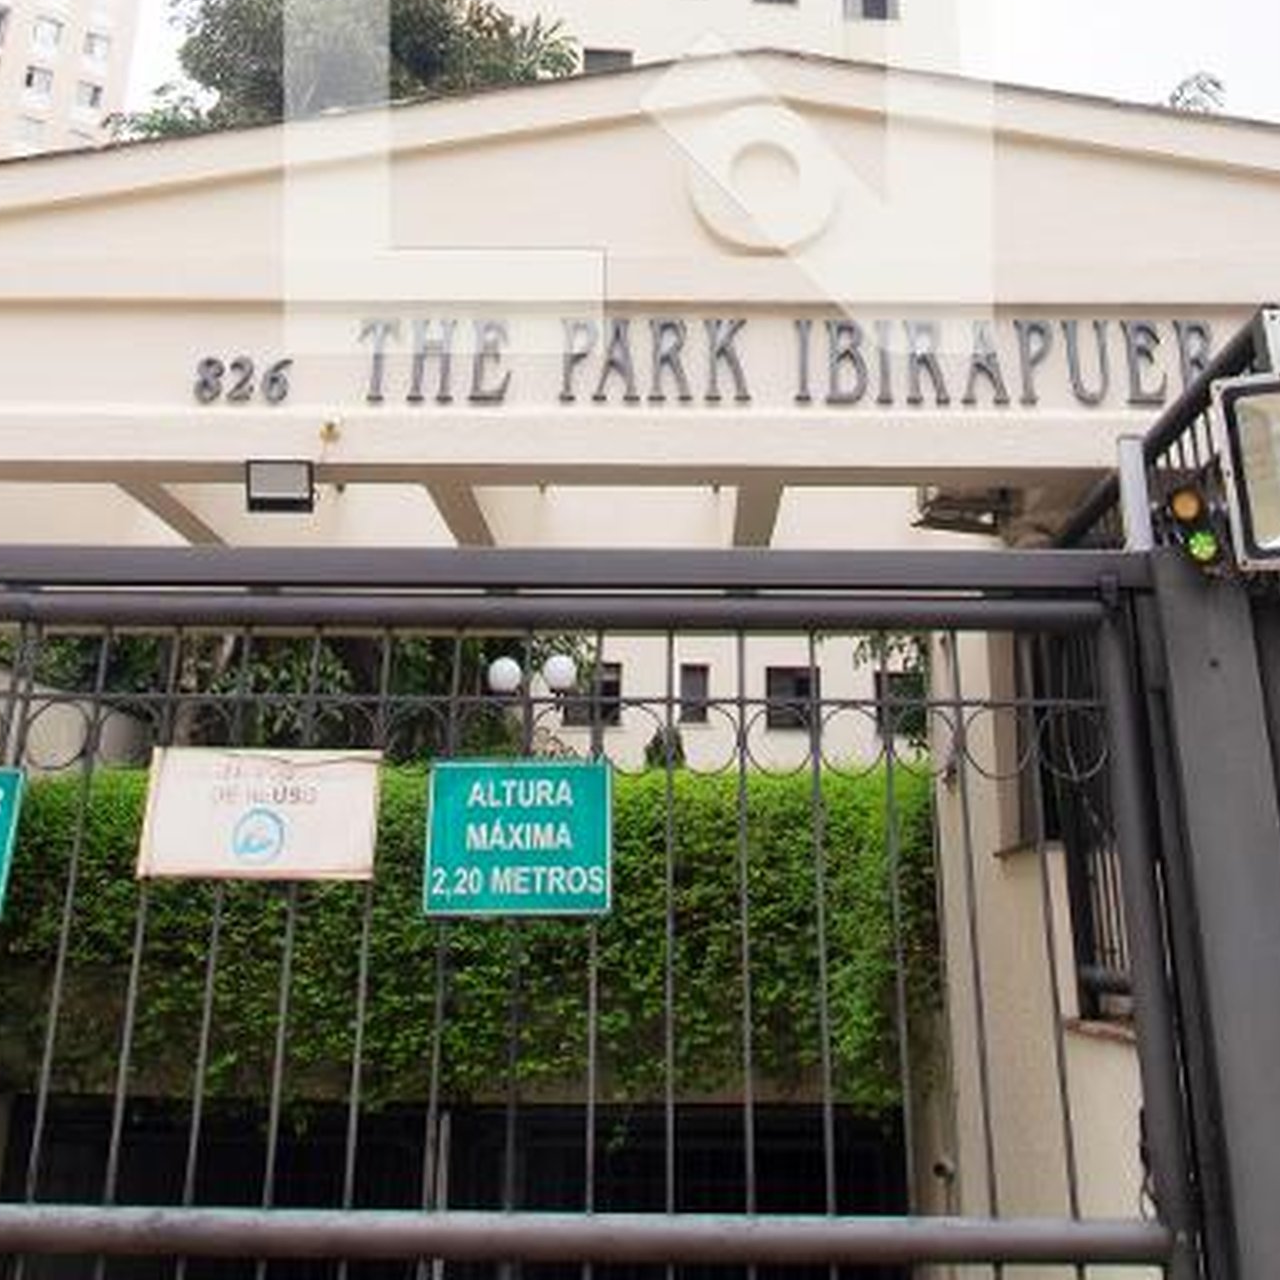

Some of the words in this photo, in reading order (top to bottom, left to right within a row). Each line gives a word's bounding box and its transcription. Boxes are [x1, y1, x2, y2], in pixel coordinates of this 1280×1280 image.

[193, 355, 294, 405] 826
[357, 318, 512, 404] THE
[559, 318, 753, 404] PARK
[466, 778, 574, 808] ALTURA
[465, 818, 574, 851] MÁXIMA
[431, 865, 483, 902] 2,20
[490, 865, 605, 895] METROS
